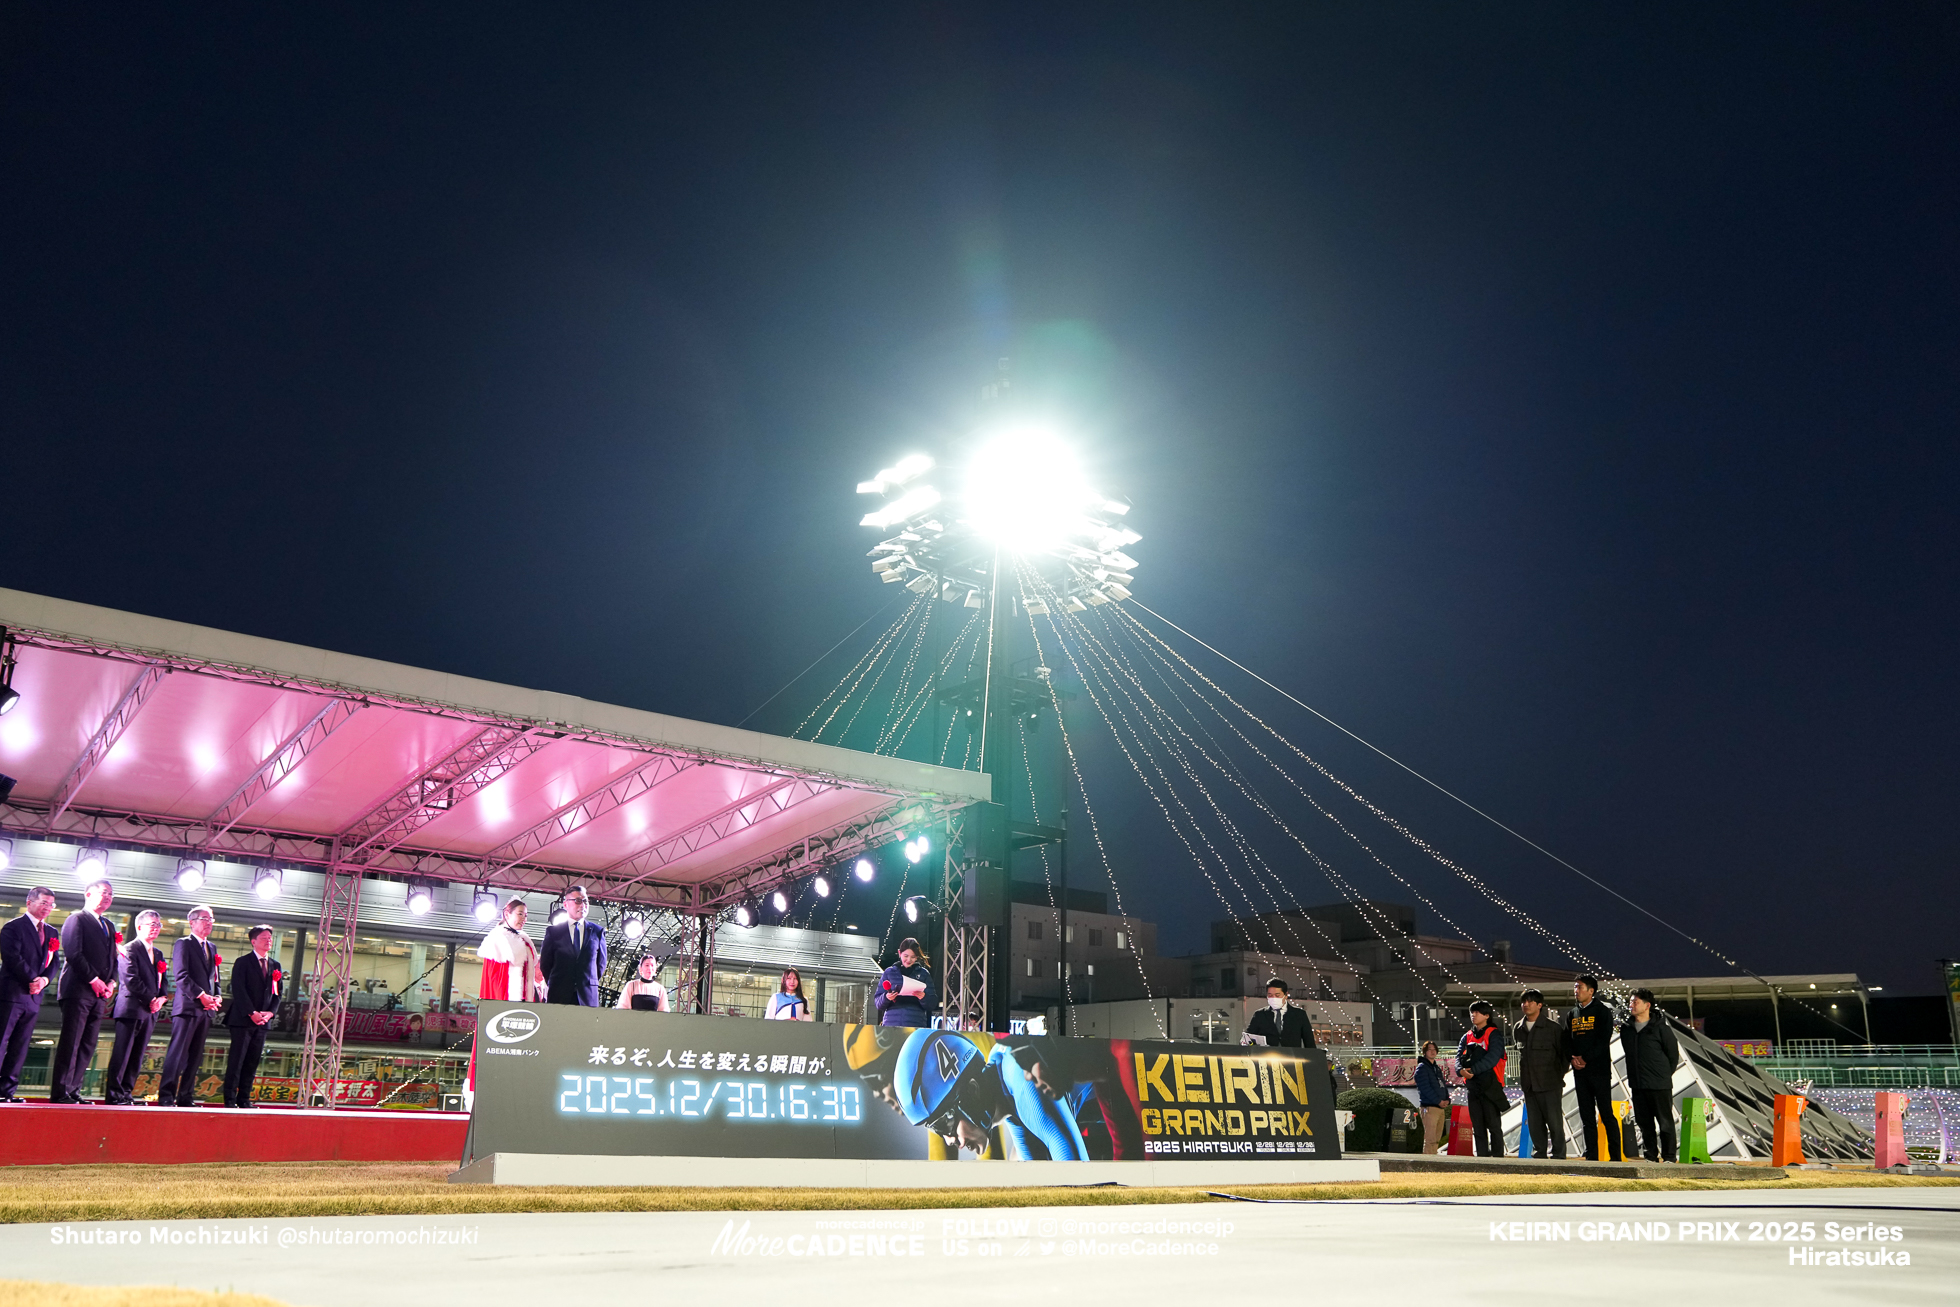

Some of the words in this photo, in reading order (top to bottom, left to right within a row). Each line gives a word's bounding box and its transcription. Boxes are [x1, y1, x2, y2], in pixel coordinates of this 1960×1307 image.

[588, 1044, 832, 1077] 来るぞ、人生を変える瞬間が。
[934, 1038, 960, 1083] 4
[1134, 1052, 1309, 1105] KEIRIN
[1619, 1102, 1627, 1117] 5
[1702, 1100, 1710, 1116] 6
[1796, 1097, 1805, 1114] 7
[1141, 1108, 1246, 1136] GRAND
[1249, 1110, 1314, 1136] PRIX
[1403, 1109, 1411, 1124] 2
[1144, 1141, 1181, 1153] 2025
[1183, 1141, 1254, 1153] HIRATSUKA
